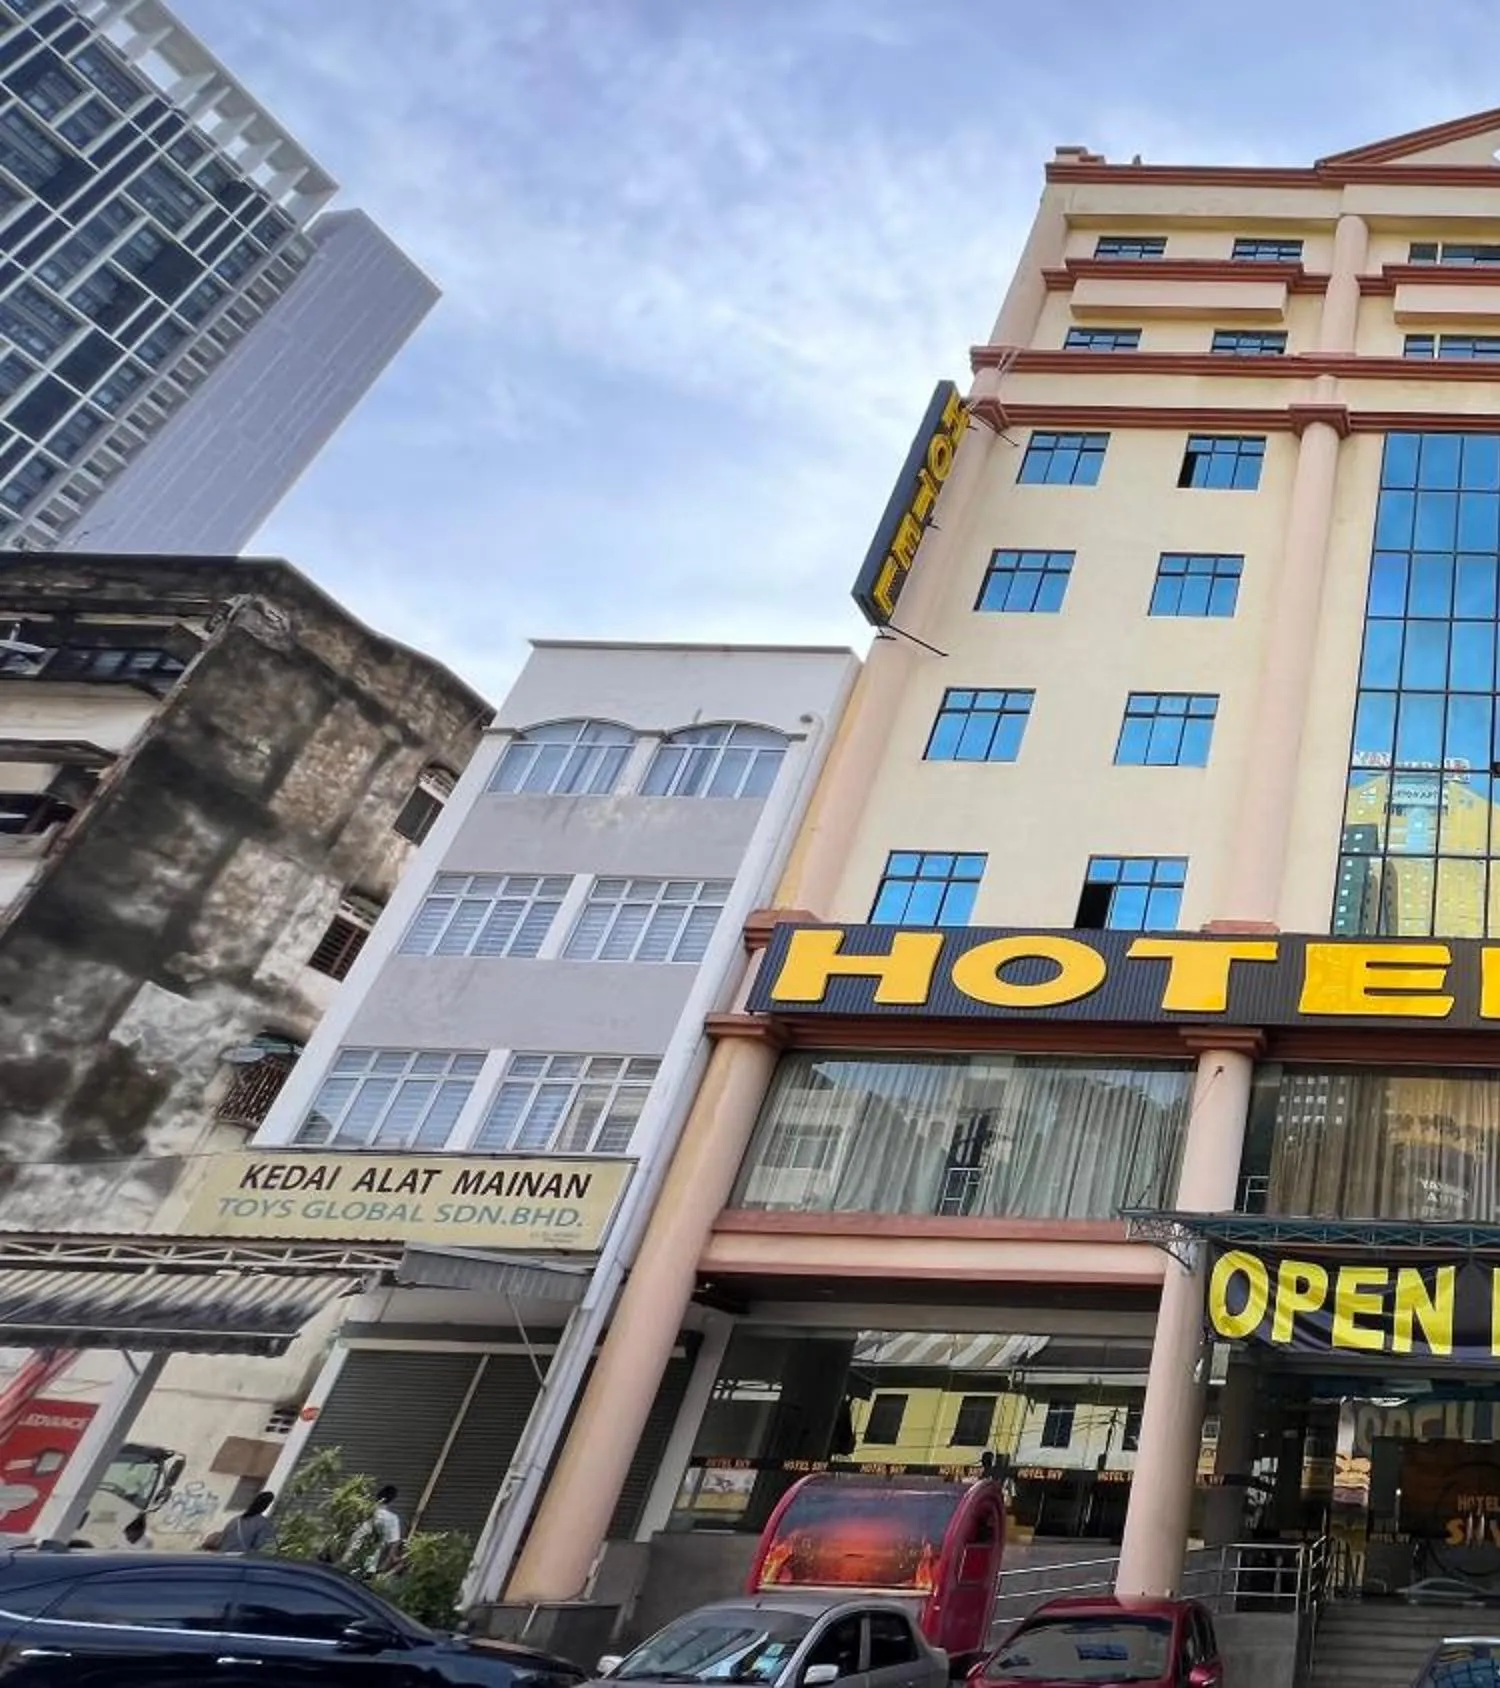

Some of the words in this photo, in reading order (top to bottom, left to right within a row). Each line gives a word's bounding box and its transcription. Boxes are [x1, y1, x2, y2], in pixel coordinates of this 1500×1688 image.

[873, 390, 971, 617] HOTEL
[218, 1198, 295, 1218] TOYS
[302, 1201, 423, 1222] GLOBAL
[239, 1163, 342, 1190] KEDAI
[352, 1167, 442, 1195] ALAT
[452, 1170, 592, 1199] MAINAN
[1209, 1249, 1456, 1355] OPEN
